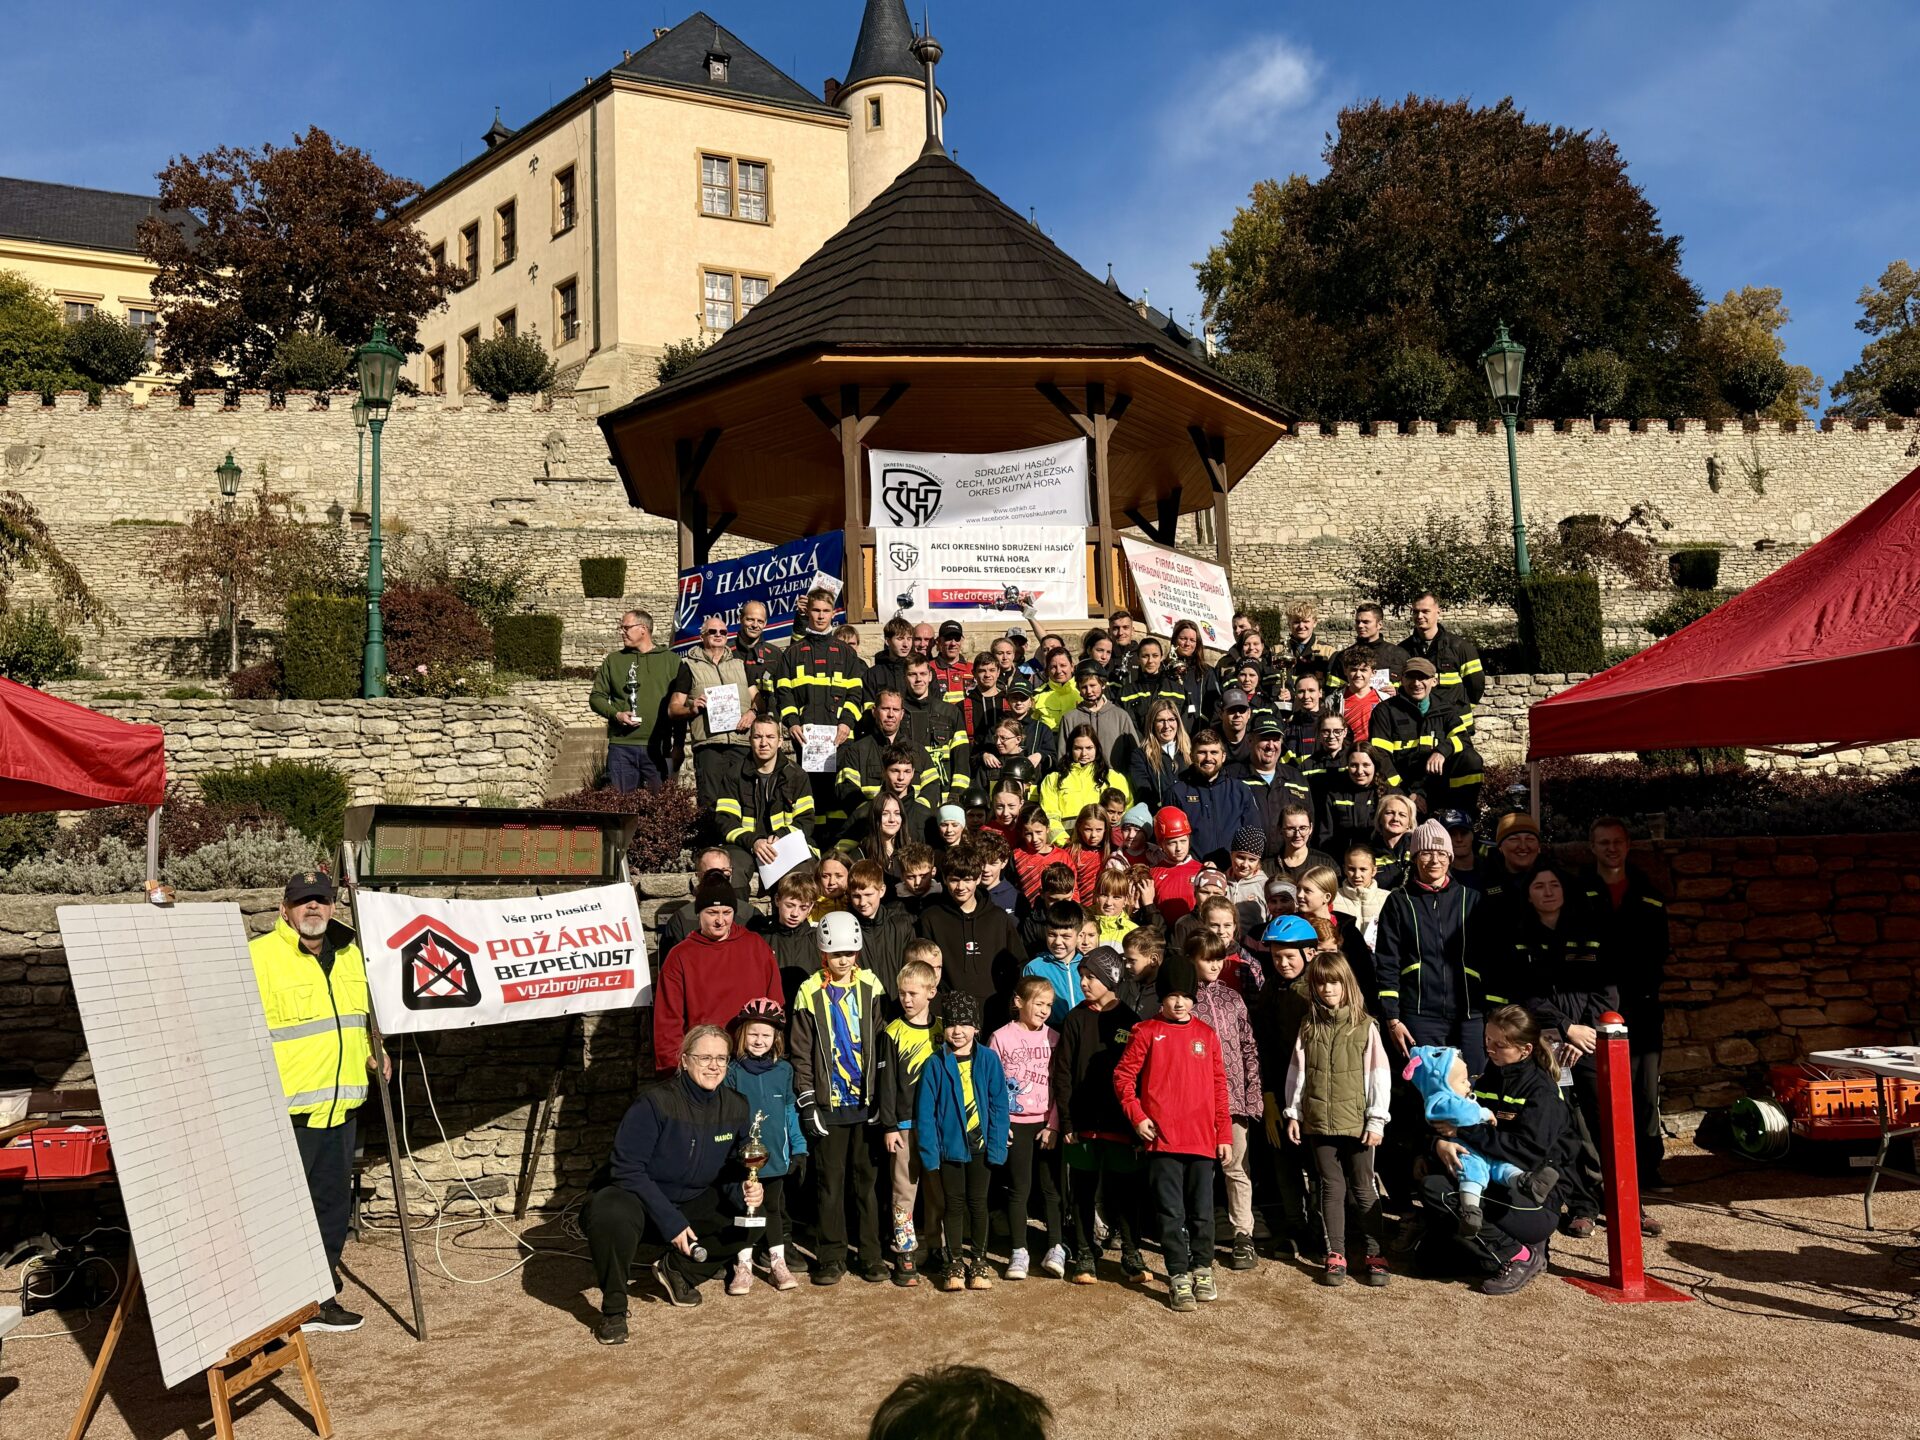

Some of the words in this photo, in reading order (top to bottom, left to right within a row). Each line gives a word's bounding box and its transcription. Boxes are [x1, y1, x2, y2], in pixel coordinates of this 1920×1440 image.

[955, 479, 985, 489] ČECH,
[987, 473, 1025, 486] MORAVY
[1033, 465, 1075, 479] SLEZSKA
[974, 462, 1020, 478] SDRUŽENÍ
[1024, 456, 1057, 470] HASIČŮ
[968, 486, 1001, 498] OKRES
[1002, 482, 1032, 494] KUTNÁ
[1033, 477, 1062, 488] HORA
[930, 543, 950, 551] AKCI
[952, 542, 1000, 551] OKRESNÍHO
[1001, 542, 1042, 552] SDRUŽENÍ
[1044, 543, 1075, 552] HASIČŮ
[715, 542, 820, 596] HASIČSKÁ
[941, 564, 982, 573] PODPOŘIL
[983, 565, 1043, 574] STŘEDOČESKÝ
[976, 554, 1005, 562] KUTNÁ
[1007, 555, 1030, 563] HORA
[1155, 556, 1176, 572] FIRMA
[1176, 563, 1194, 577] SABE
[768, 576, 815, 597] VZÁJEMN
[1160, 583, 1172, 593] PRO
[1161, 571, 1200, 590] DODAVATEL
[1148, 596, 1157, 605] NA
[502, 914, 527, 924] Vše
[530, 912, 553, 923] pro
[555, 902, 602, 917] hasiče!
[486, 916, 633, 961] POŽÁRNÍ
[494, 948, 635, 980] BEZPEČNOST
[516, 974, 622, 999] vyzbrojna.cz
